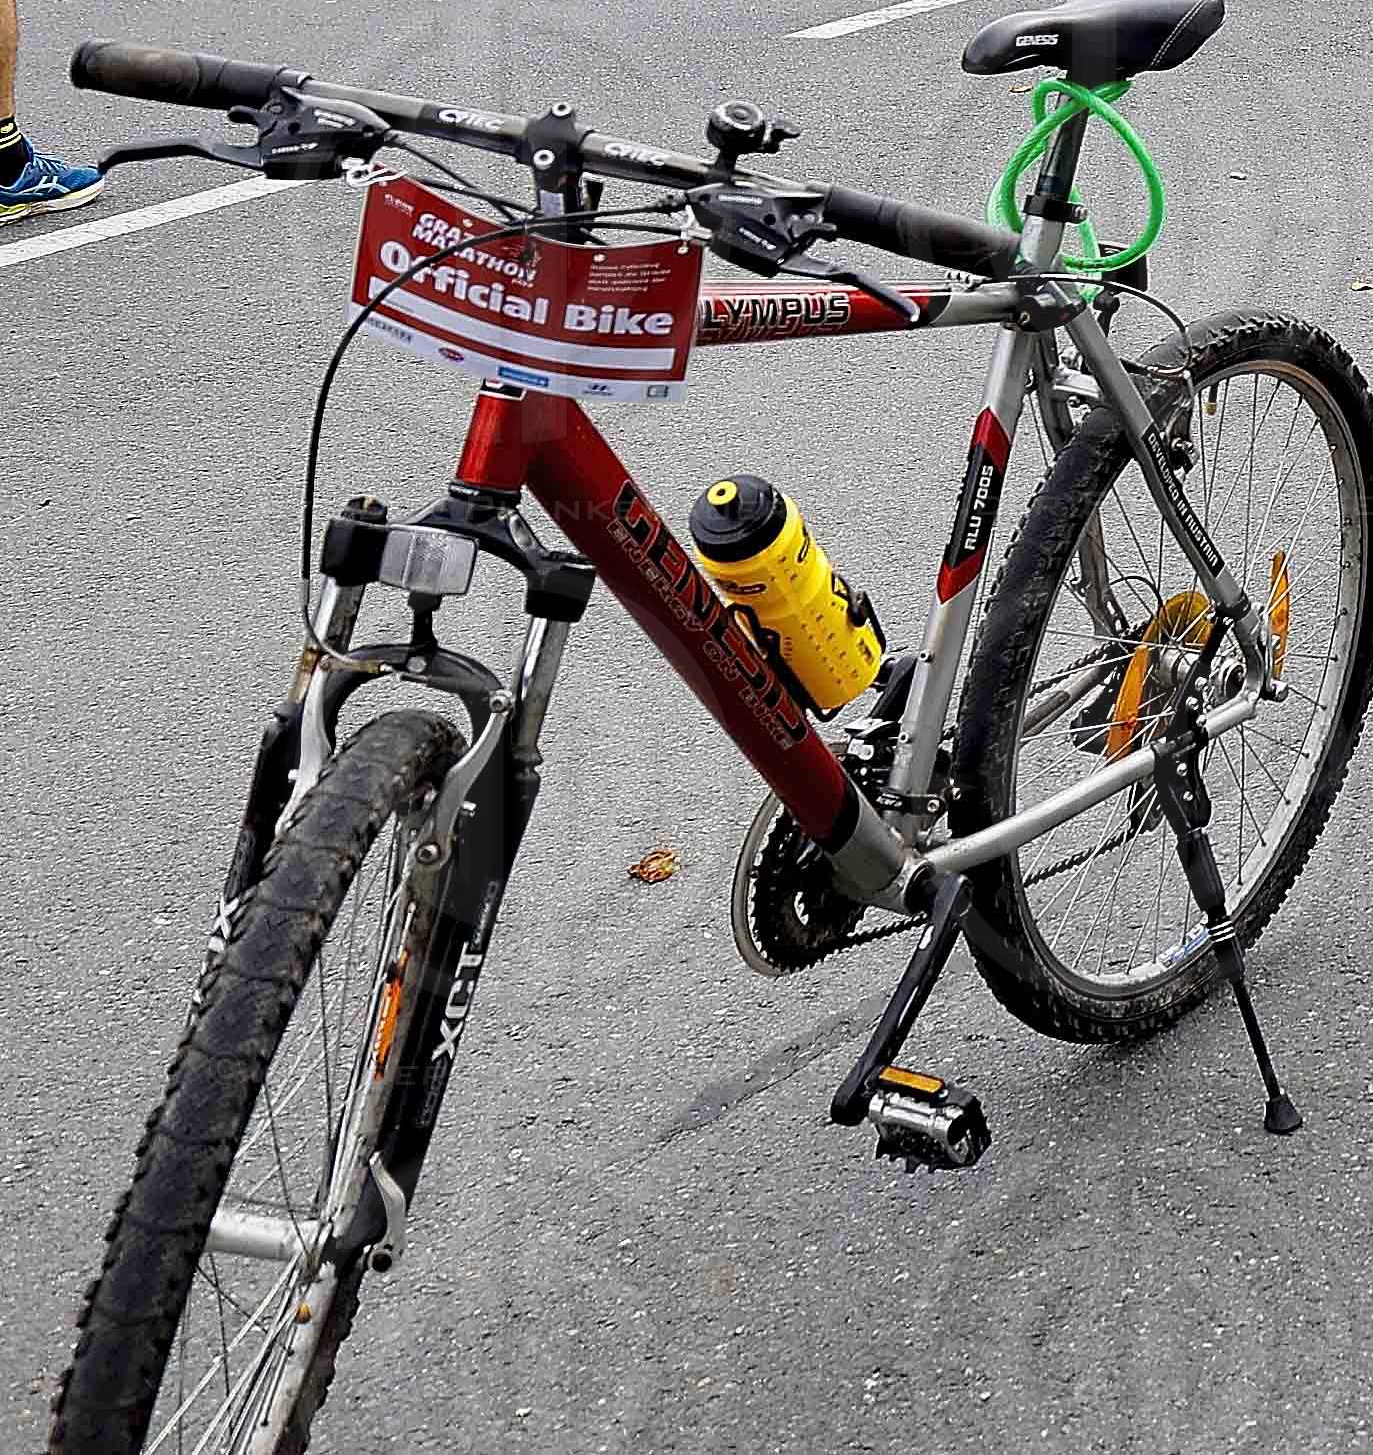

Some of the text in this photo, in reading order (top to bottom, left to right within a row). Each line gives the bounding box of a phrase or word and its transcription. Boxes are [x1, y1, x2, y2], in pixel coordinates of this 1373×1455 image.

[563, 304, 675, 335] Bike
[702, 293, 849, 326] LYMPUS
[432, 940, 483, 1061] XCT
